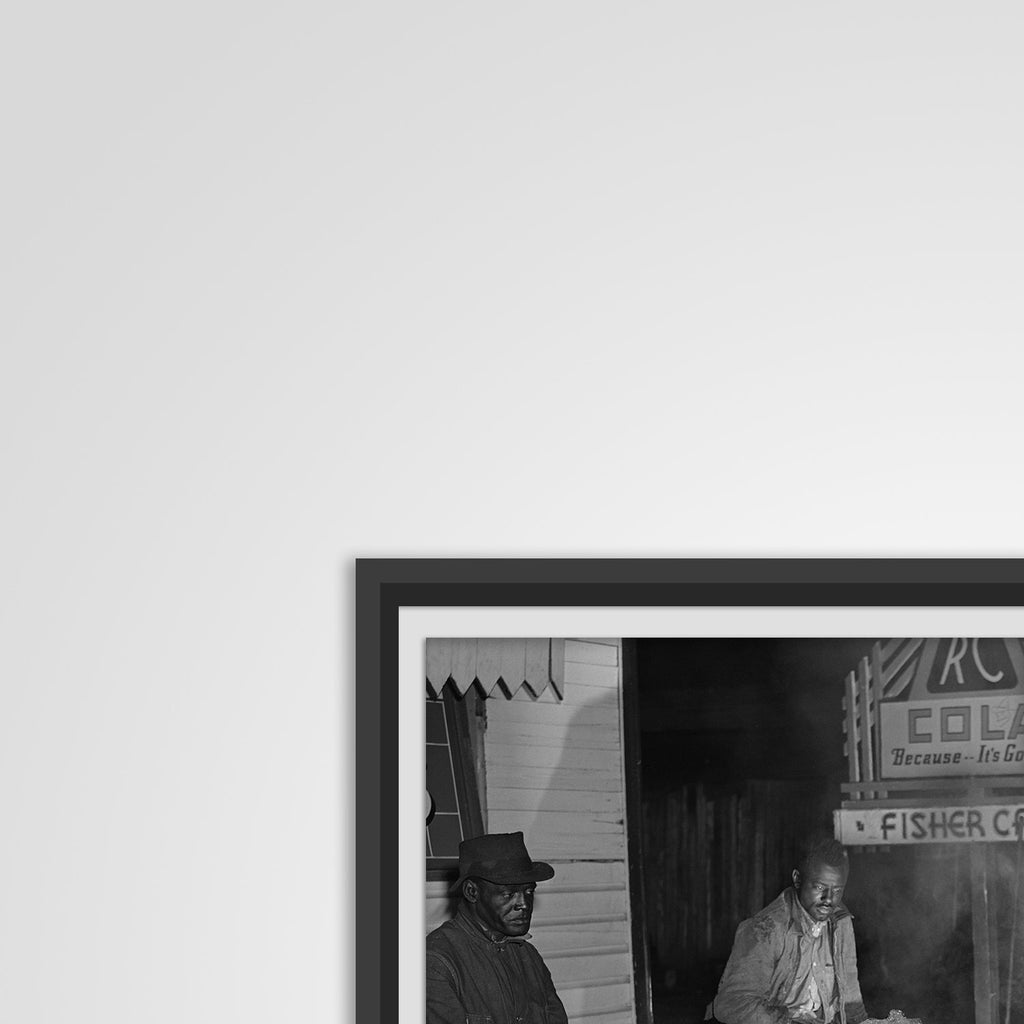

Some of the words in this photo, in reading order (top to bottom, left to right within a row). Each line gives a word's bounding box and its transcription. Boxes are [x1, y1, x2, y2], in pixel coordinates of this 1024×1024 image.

[939, 638, 1004, 685] RC
[891, 747, 961, 766] Because
[881, 809, 986, 840] FISHER
